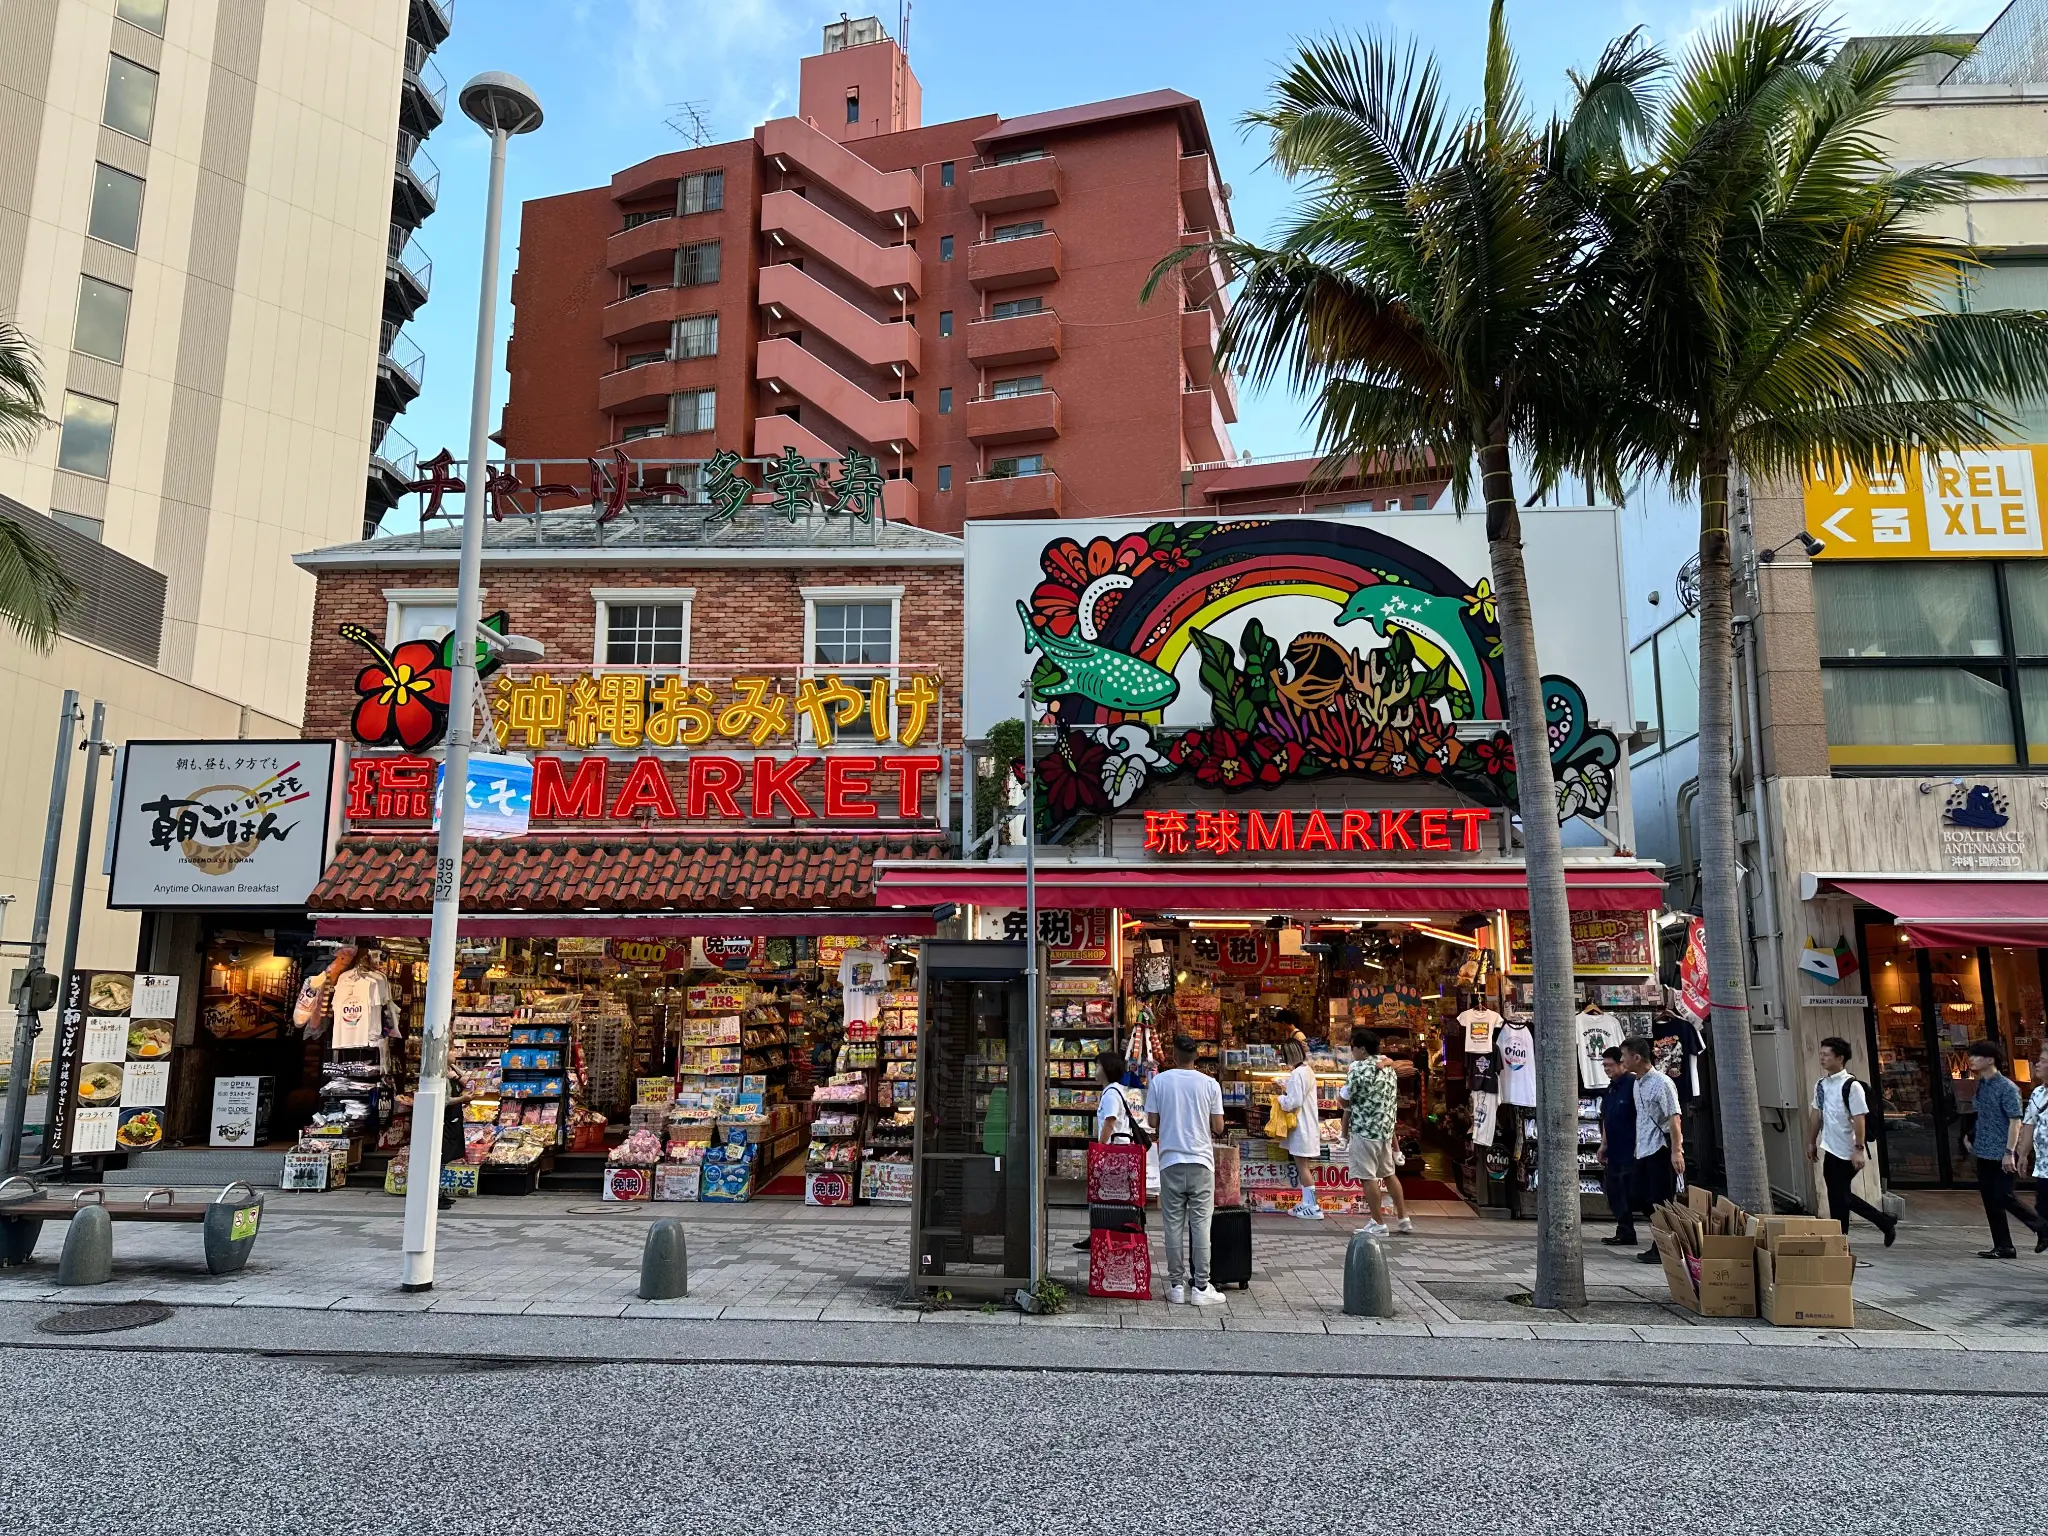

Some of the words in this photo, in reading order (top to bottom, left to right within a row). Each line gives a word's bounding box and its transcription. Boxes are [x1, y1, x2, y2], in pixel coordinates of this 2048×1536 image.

[1938, 465, 2022, 499] REL
[1820, 507, 1911, 543] くる
[1941, 503, 2027, 536] XLE
[493, 672, 943, 749] 沖縄おみやげ
[176, 757, 279, 771] 朝も、昼も、夕方でも
[245, 776, 303, 809] いつでも
[530, 755, 943, 819] MARKET
[141, 794, 302, 852] 朝ごはん
[438, 858, 454, 871] 39
[1951, 856, 2021, 867] 沖縄・国際通り
[436, 871, 453, 884] R3
[154, 884, 189, 894] Anytime
[191, 884, 235, 893] Okinawan
[237, 884, 280, 893] Breakfast
[435, 885, 452, 897] P7
[619, 941, 667, 962] 1000
[1081, 950, 1105, 960] SHOP
[1194, 935, 1258, 963] 免税
[61, 975, 82, 1057] いつでも朝ごはん
[1505, 1045, 1526, 1058] Orion
[77, 1111, 113, 1120] タコライス
[1486, 1152, 1509, 1165] Orion
[613, 1178, 639, 1192] 免税
[813, 1182, 841, 1196] 免税
